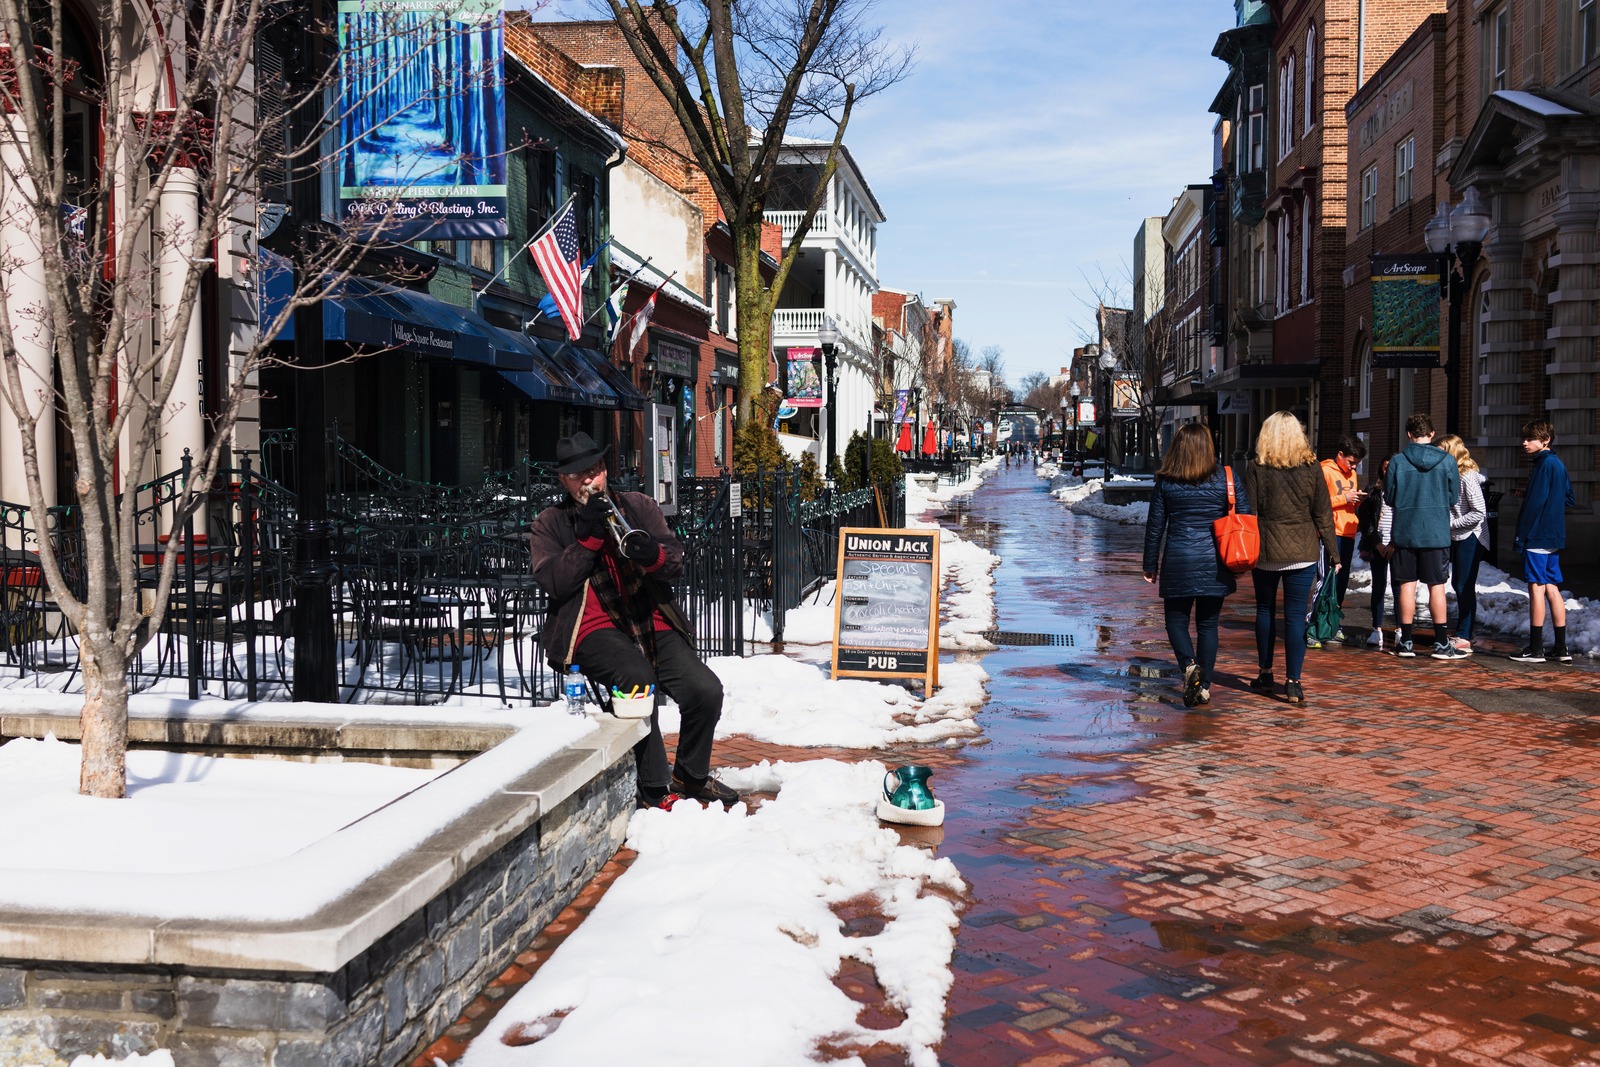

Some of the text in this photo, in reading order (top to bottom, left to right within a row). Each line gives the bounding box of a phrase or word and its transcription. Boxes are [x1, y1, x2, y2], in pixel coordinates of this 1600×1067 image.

[408, 187, 436, 196] PIERS
[437, 187, 478, 196] CHAPIN
[417, 202, 428, 215] &
[428, 201, 475, 218] Blasting,
[477, 201, 499, 214] Inc.
[1383, 263, 1427, 274] ArtScape
[393, 323, 453, 350] Village Square Restaurant
[847, 536, 929, 553] UNION JACK
[867, 656, 898, 670] PUB
